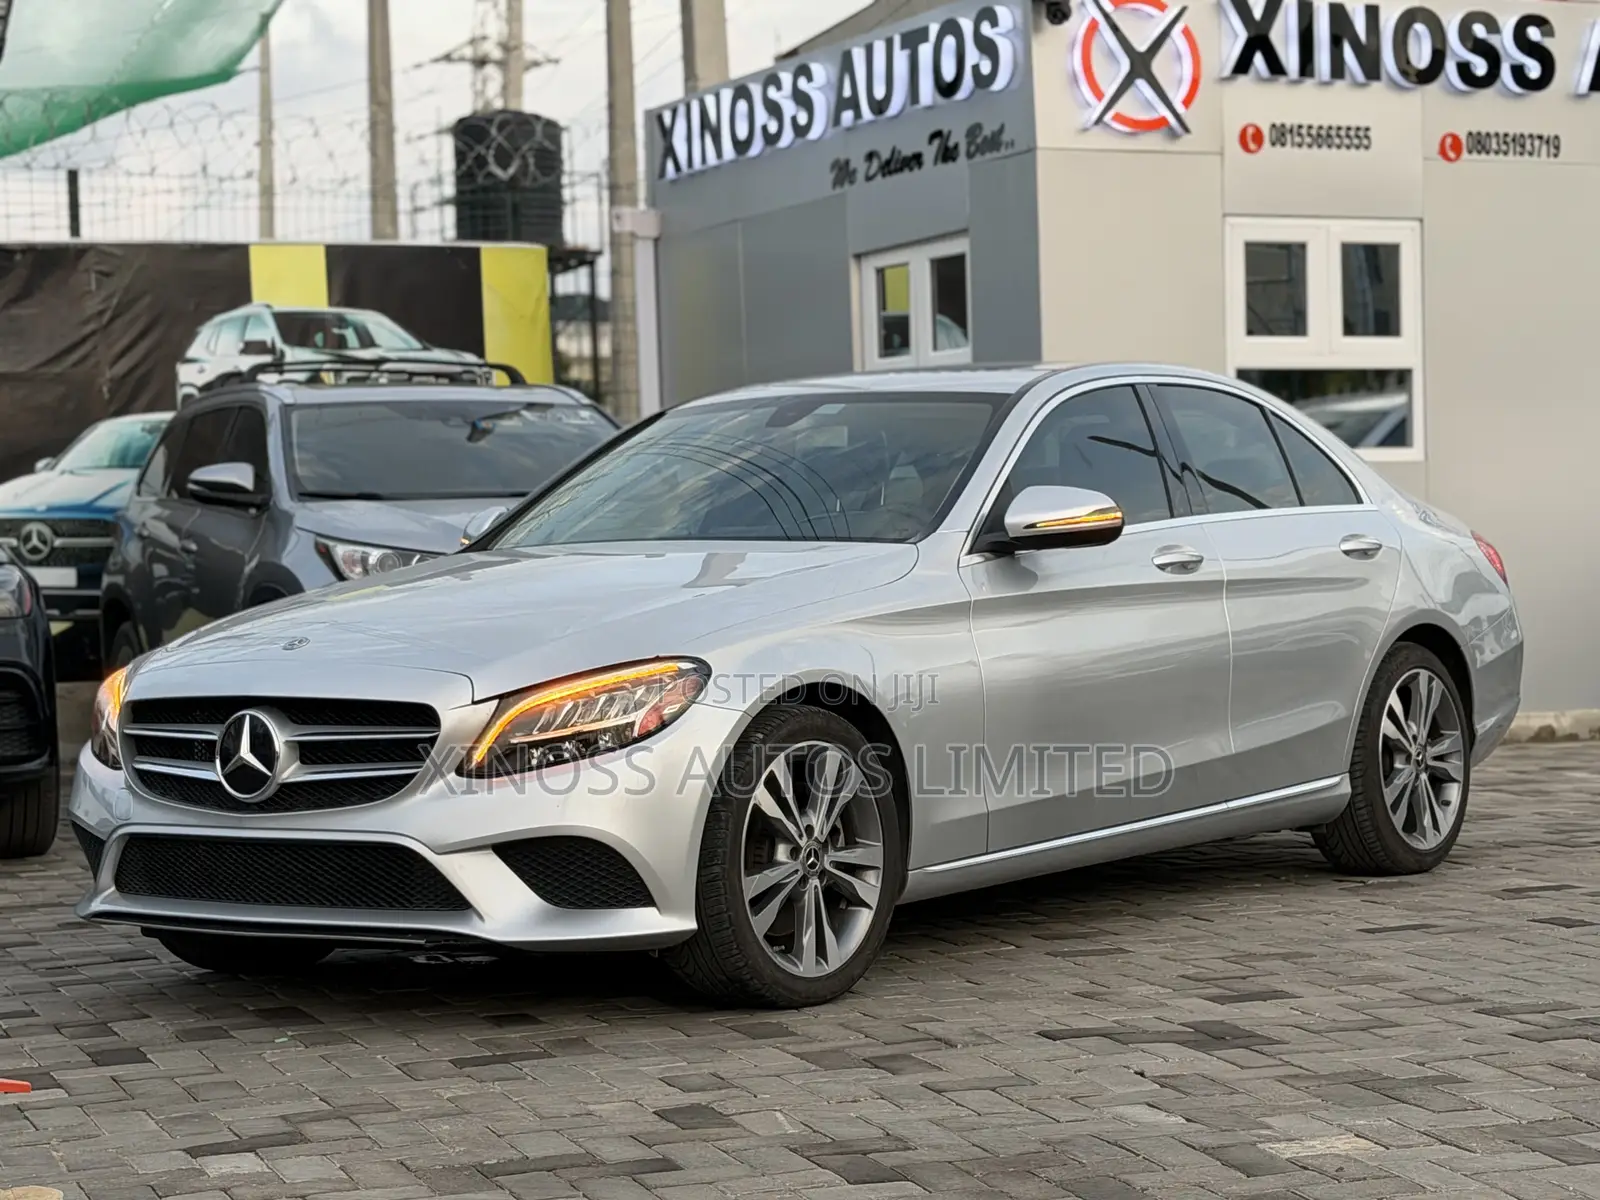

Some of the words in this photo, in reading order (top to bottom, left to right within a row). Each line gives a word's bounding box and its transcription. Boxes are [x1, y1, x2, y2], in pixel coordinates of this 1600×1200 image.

[1222, 0, 1556, 95] XINOSS
[658, 62, 826, 182] XINOSS
[832, 4, 1013, 128] AUTOS
[928, 129, 959, 166] The
[1269, 123, 1372, 150] 08155665555
[1466, 130, 1562, 158] 08035193719
